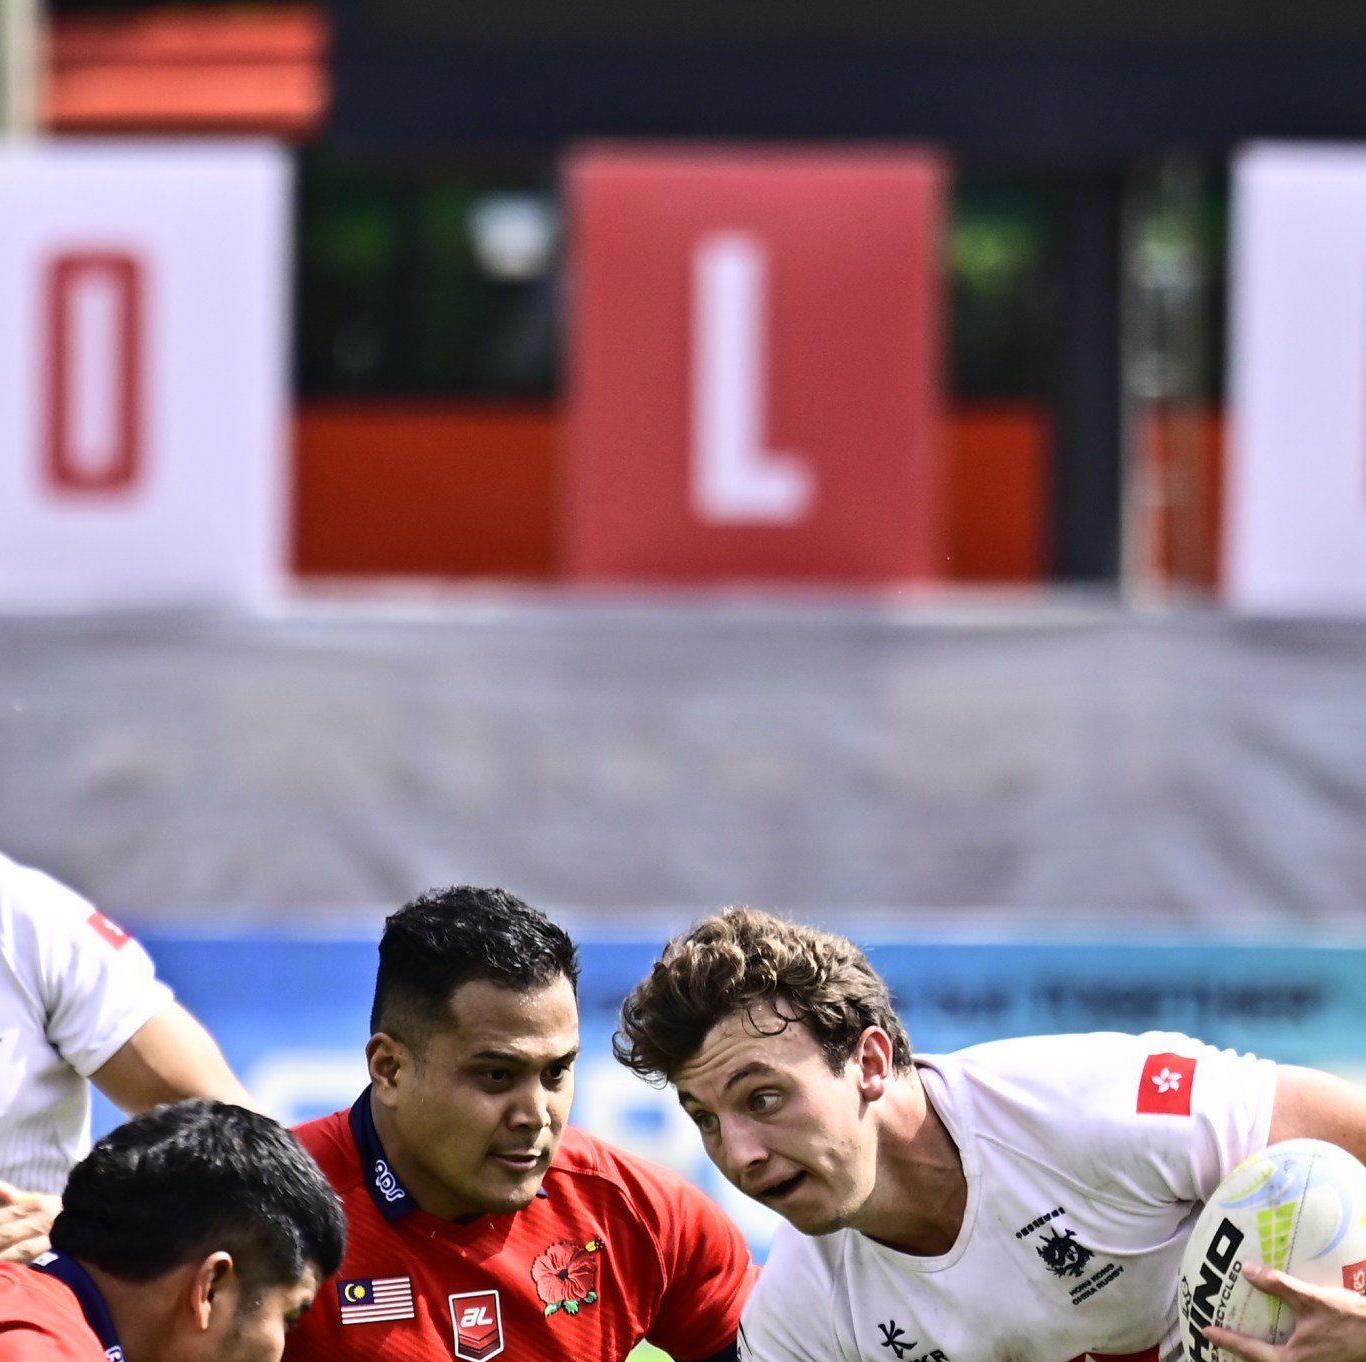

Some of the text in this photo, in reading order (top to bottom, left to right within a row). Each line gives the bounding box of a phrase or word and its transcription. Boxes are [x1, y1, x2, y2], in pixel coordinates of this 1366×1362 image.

[42, 246, 146, 502] O
[692, 233, 813, 524] L
[1215, 1260, 1243, 1329] ECYCLED
